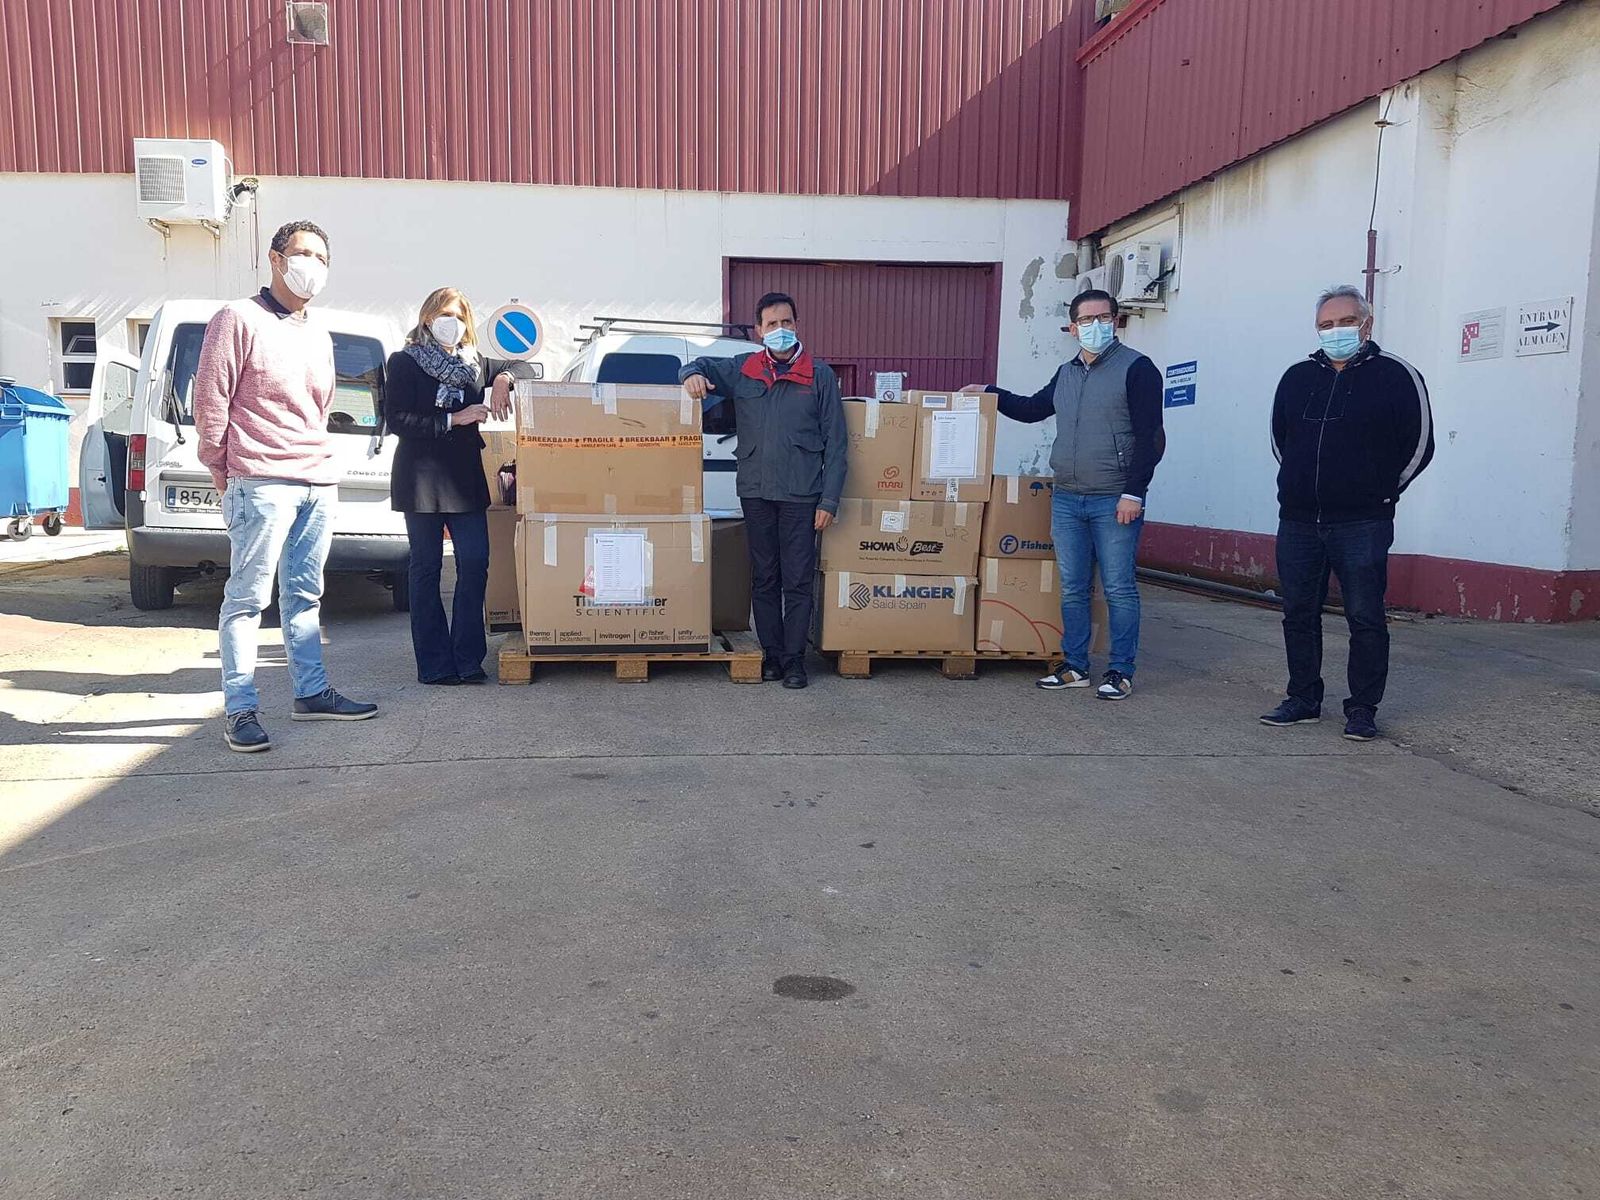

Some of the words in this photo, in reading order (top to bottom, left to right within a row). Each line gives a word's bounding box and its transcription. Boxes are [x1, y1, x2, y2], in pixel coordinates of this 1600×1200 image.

[1519, 309, 1567, 325] ENTRADA
[1519, 332, 1566, 347] ALMACEN
[527, 435, 573, 443] BREEKBAAR
[859, 541, 896, 552] SHOWA
[1020, 540, 1054, 550] Fisher
[872, 585, 955, 599] KLNGER
[898, 600, 927, 611] Spain
[575, 608, 666, 617] SCIENTIFIC
[559, 630, 582, 638] applied
[599, 632, 631, 640] invitrogen
